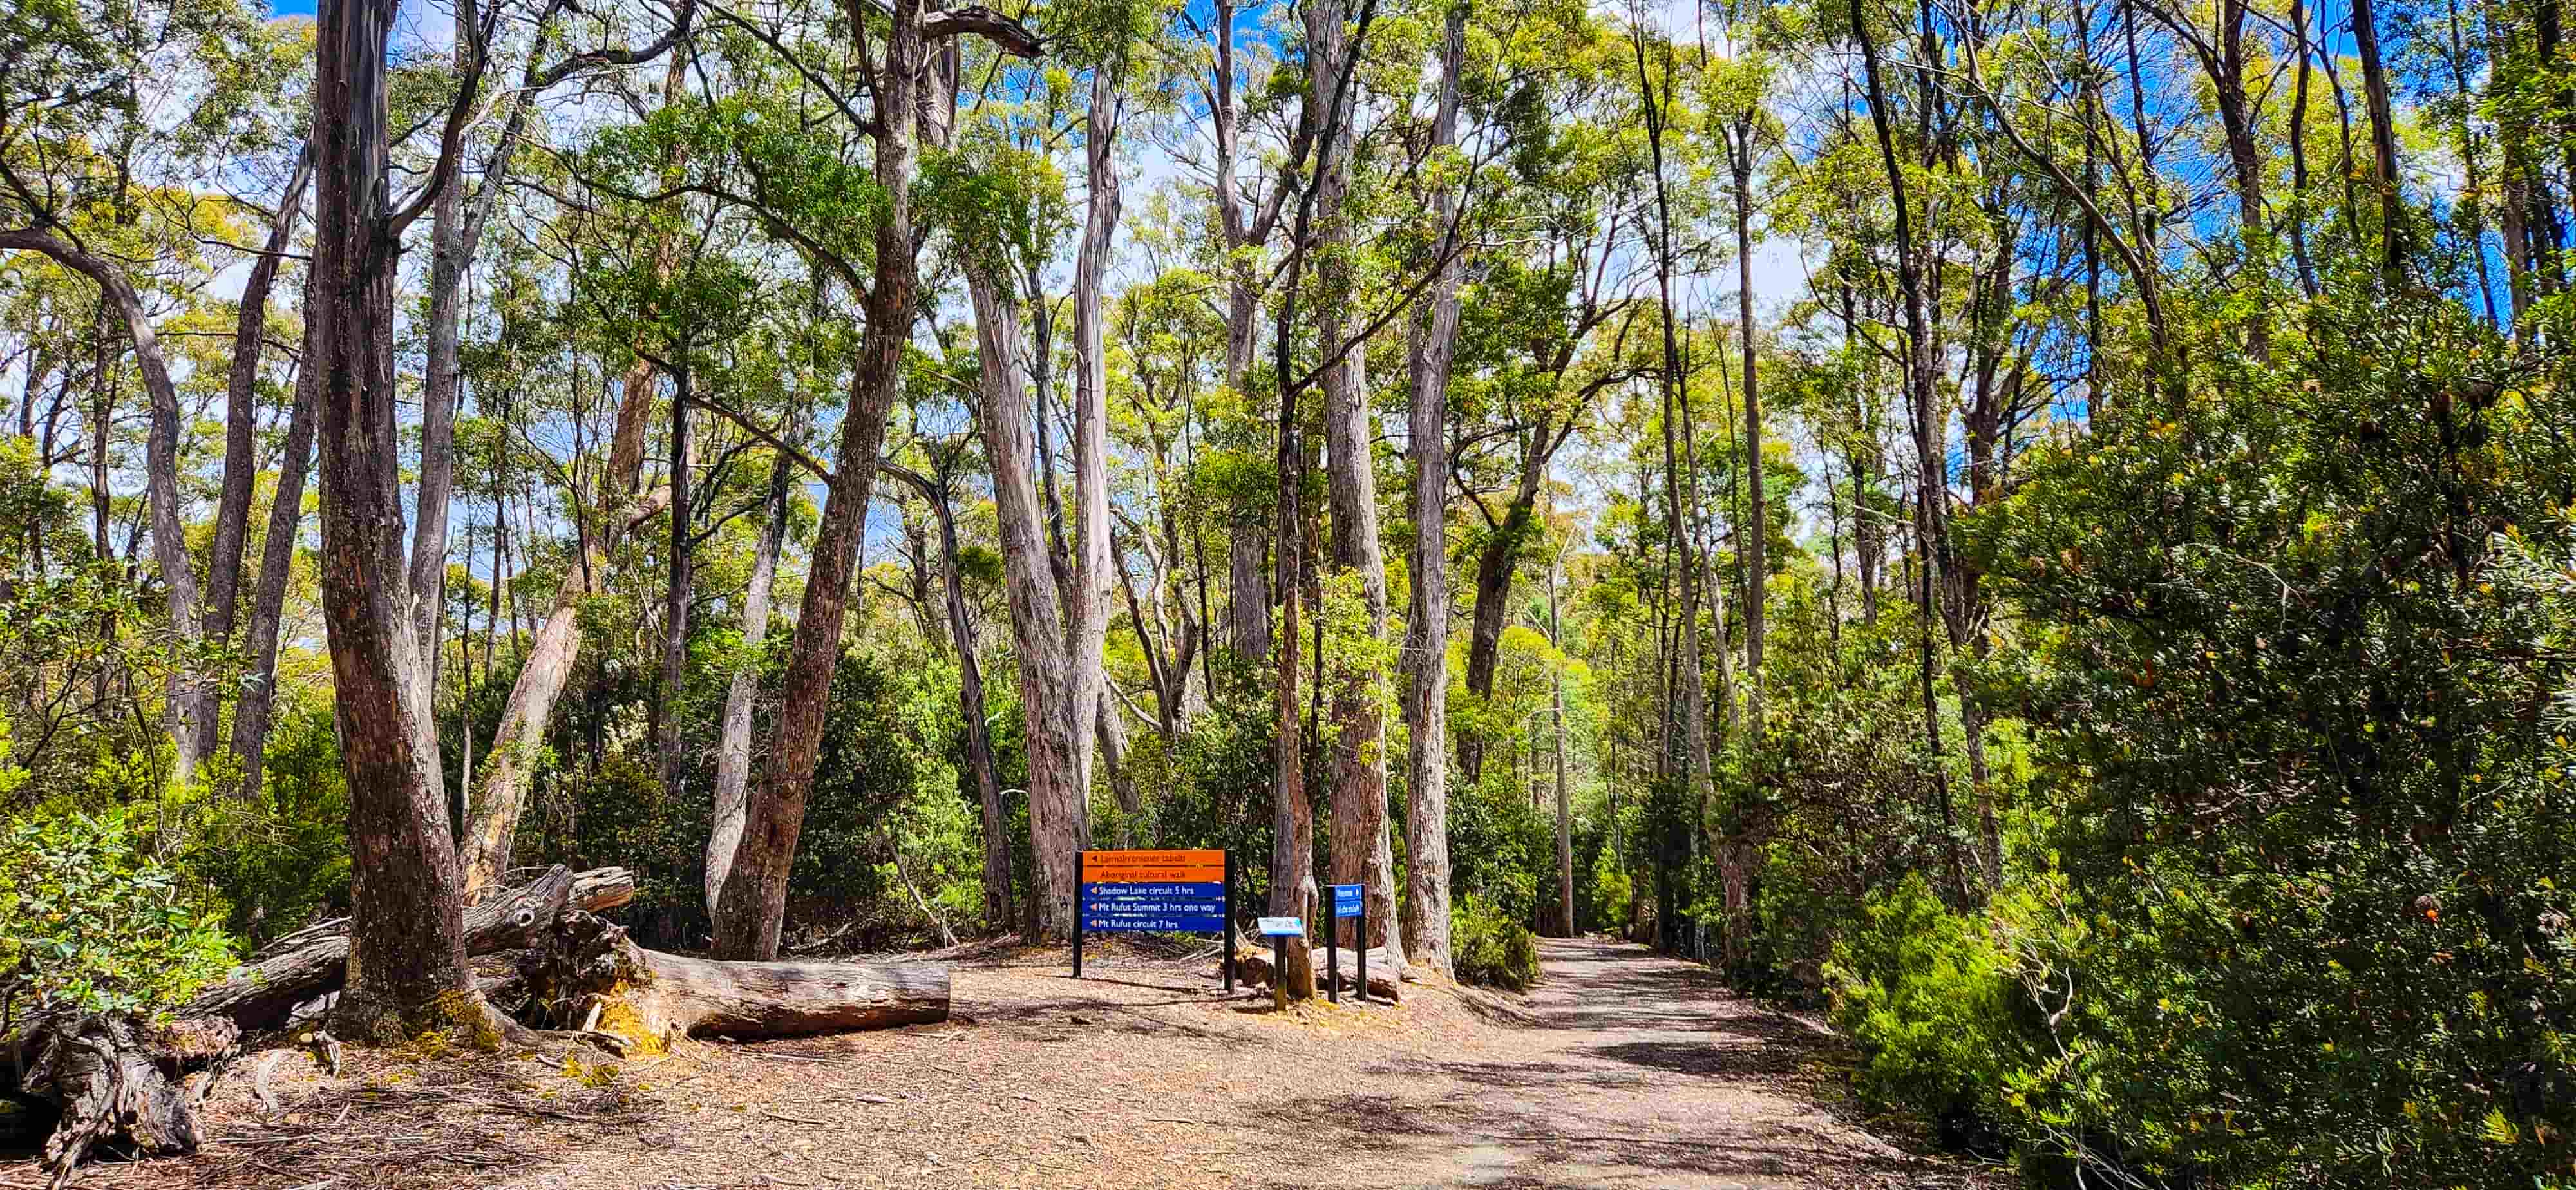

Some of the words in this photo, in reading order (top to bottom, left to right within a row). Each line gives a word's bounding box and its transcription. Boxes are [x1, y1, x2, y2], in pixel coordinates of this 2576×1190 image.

[1099, 886, 1128, 895] Shadow
[1130, 886, 1147, 894] Lake
[1149, 886, 1172, 894] circuit
[1175, 886, 1180, 894] 5
[1182, 886, 1195, 894] hrs
[1099, 903, 1109, 911] Mt
[1111, 902, 1131, 911] Rufus
[1133, 902, 1160, 911] Summit
[1162, 902, 1168, 911] 3
[1170, 902, 1182, 911] hrs
[1200, 905, 1215, 913] way
[1099, 920, 1109, 928] Mt
[1111, 919, 1132, 928] Rufus
[1133, 919, 1157, 928] circuit
[1159, 920, 1164, 928] 7
[1166, 920, 1178, 928] hrs
